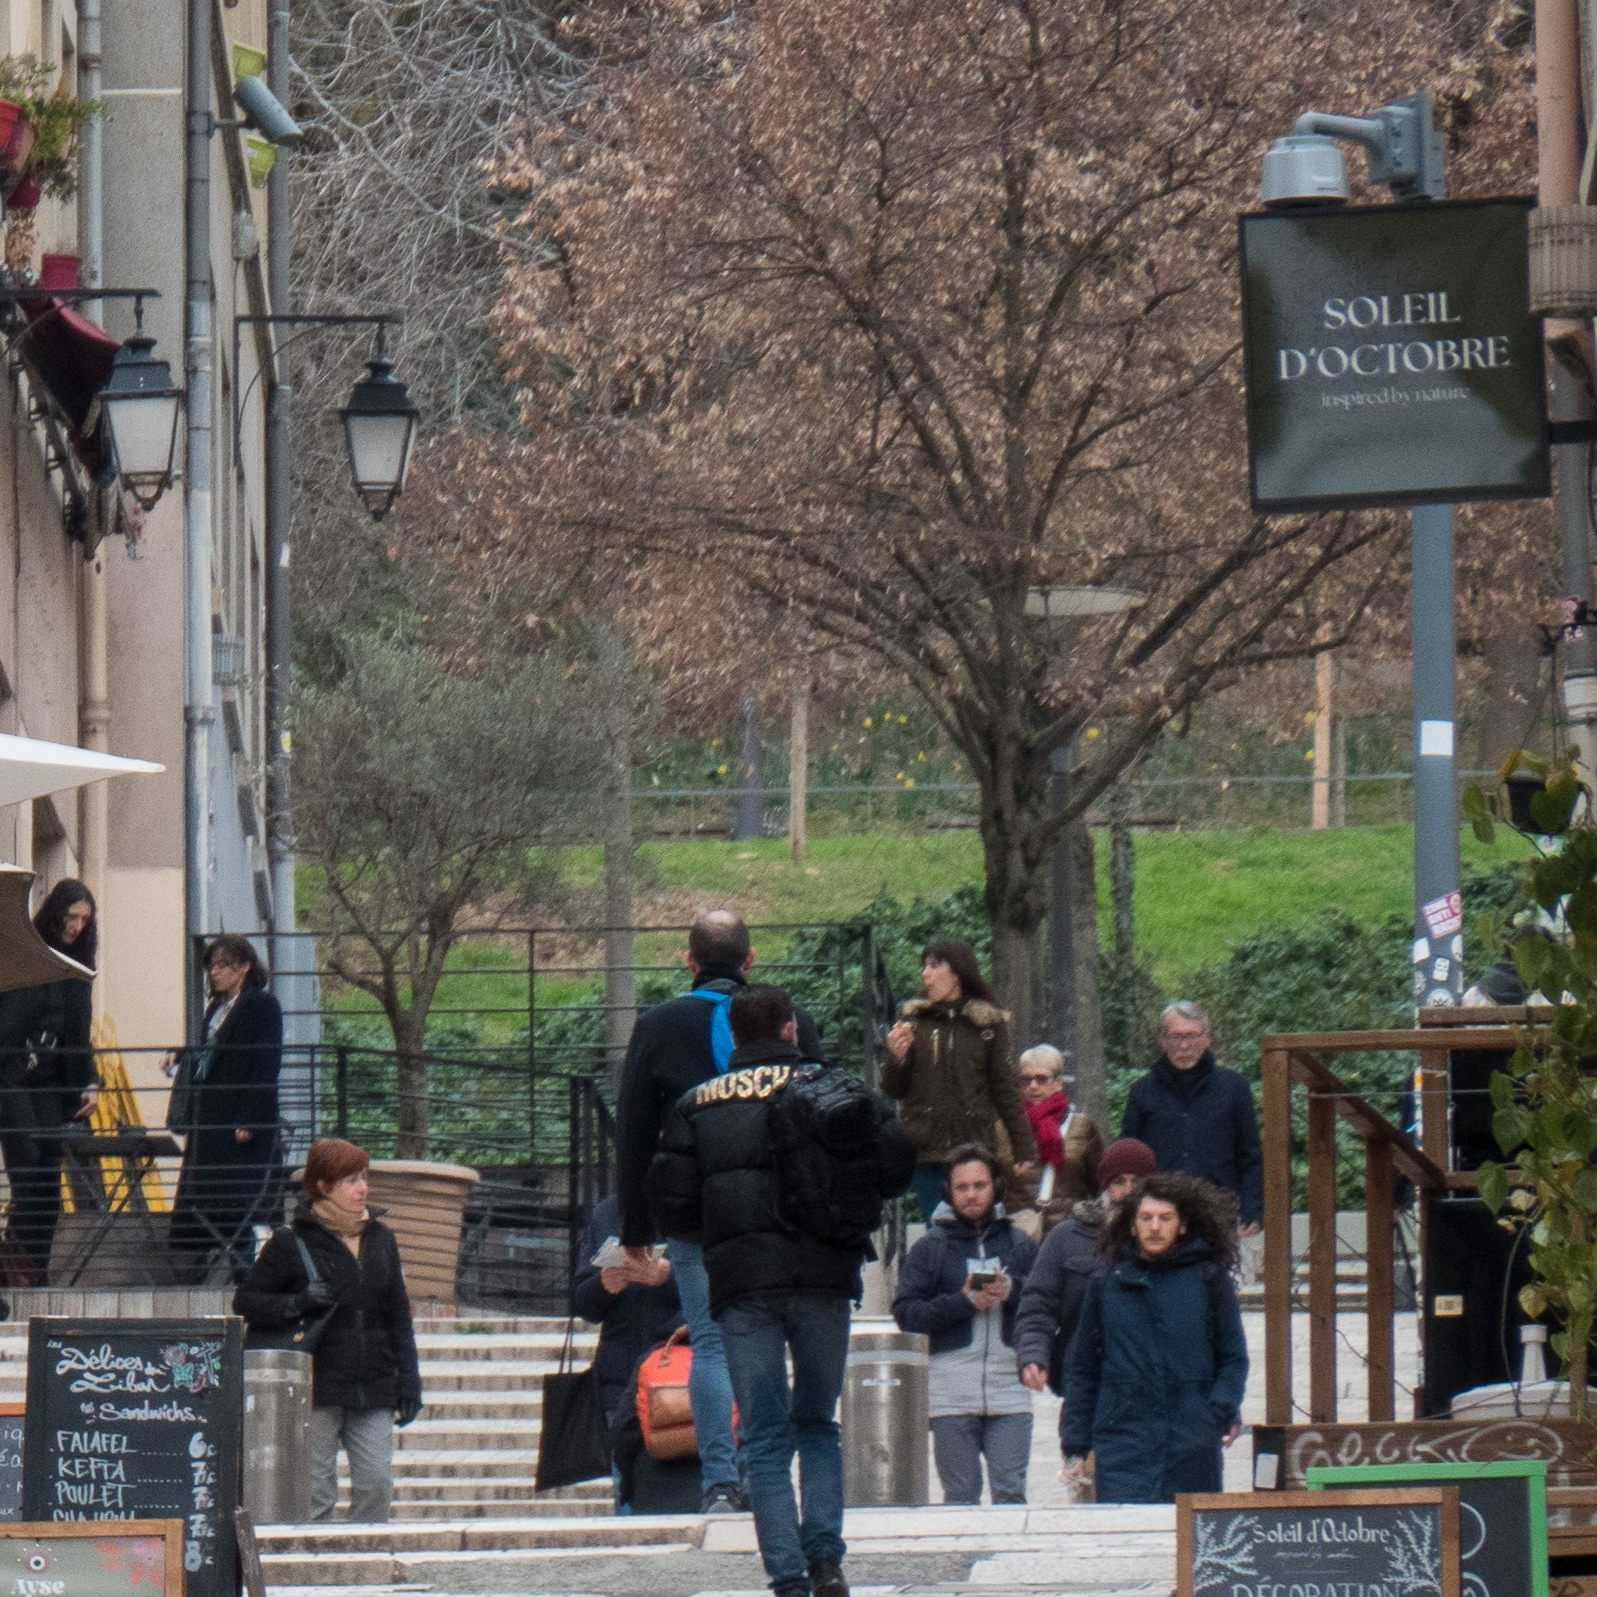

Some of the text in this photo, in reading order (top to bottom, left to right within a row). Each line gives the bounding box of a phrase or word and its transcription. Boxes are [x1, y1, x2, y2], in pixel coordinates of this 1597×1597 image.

[1323, 291, 1461, 329] SOLEIL
[1278, 335, 1511, 380] D'OCTOBRE
[1322, 384, 1470, 409] inspired by nature
[56, 1430, 138, 1455] FALAFEL
[57, 1457, 127, 1483] KEFTA
[55, 1483, 138, 1508] POULET
[1253, 1517, 1303, 1544] Soleil
